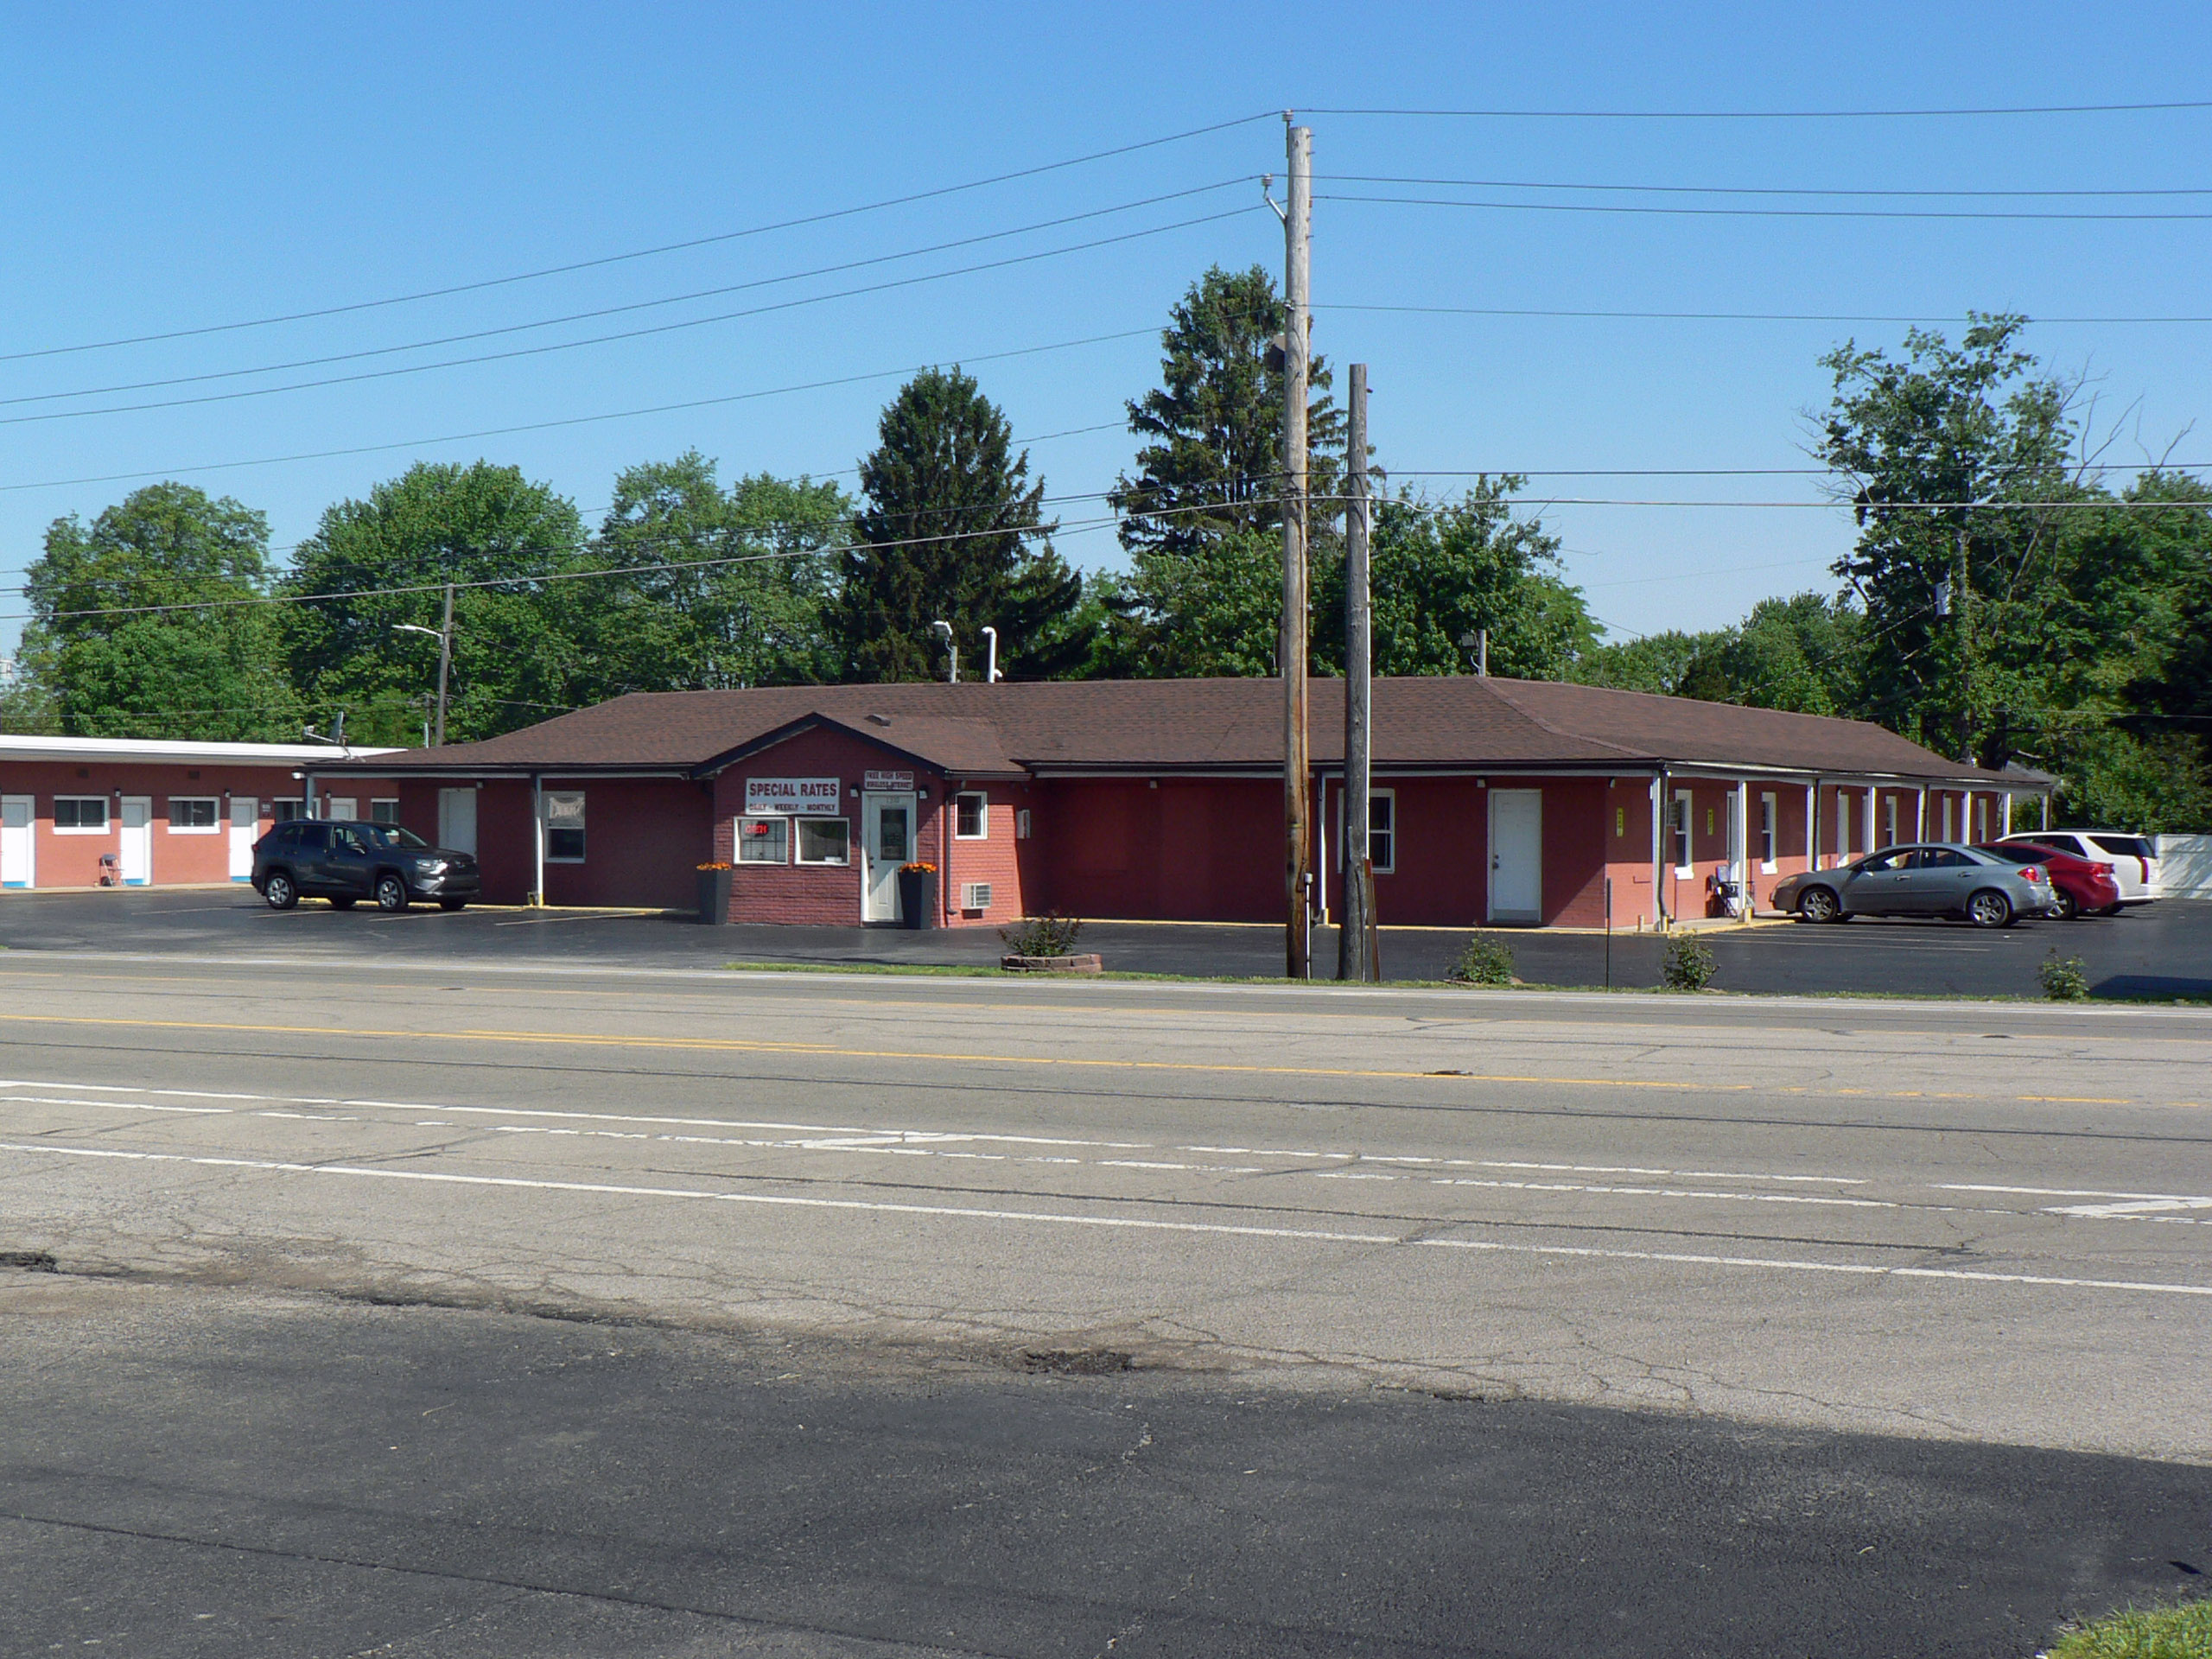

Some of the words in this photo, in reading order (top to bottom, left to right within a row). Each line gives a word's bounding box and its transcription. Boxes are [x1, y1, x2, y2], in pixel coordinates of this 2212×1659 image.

[749, 783, 796, 797] SPECIAL
[800, 783, 837, 797] RATES
[745, 823, 768, 834] OPEN
